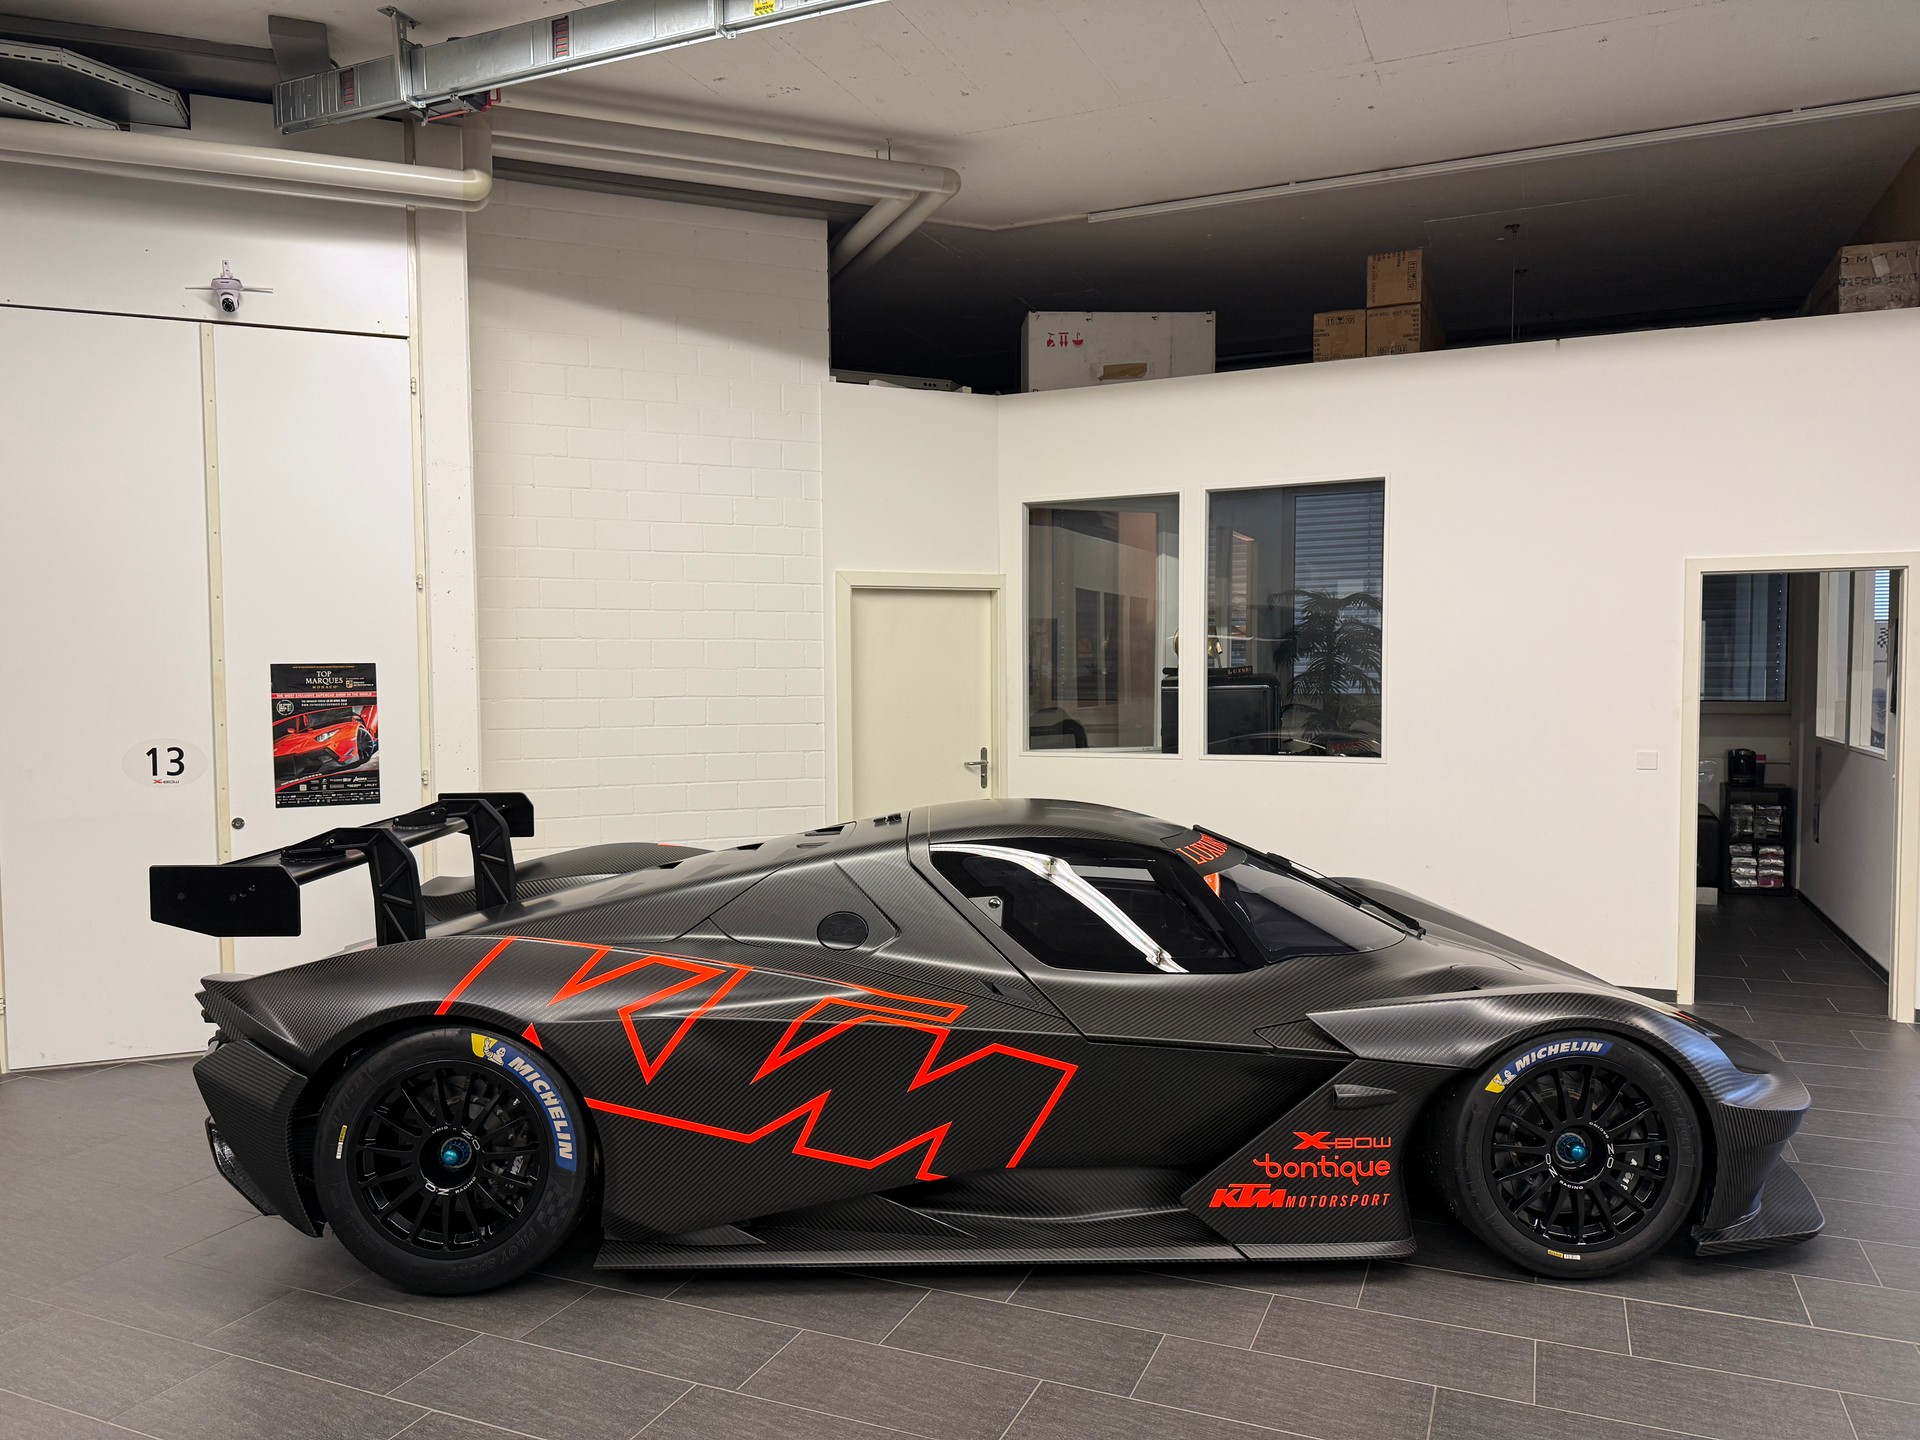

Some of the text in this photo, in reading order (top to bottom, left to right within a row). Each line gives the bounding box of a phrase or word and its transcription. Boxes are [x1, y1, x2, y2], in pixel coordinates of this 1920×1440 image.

[305, 677, 343, 685] MARQUES
[146, 747, 184, 776] 13
[1514, 1041, 1603, 1072] MICHELIN
[508, 1056, 573, 1160] MICHELIN
[1252, 1153, 1391, 1186] bontique
[454, 1176, 477, 1194] RACING
[1208, 1183, 1391, 1208] KTM MOTORSPORT
[1559, 1180, 1584, 1190] RACING
